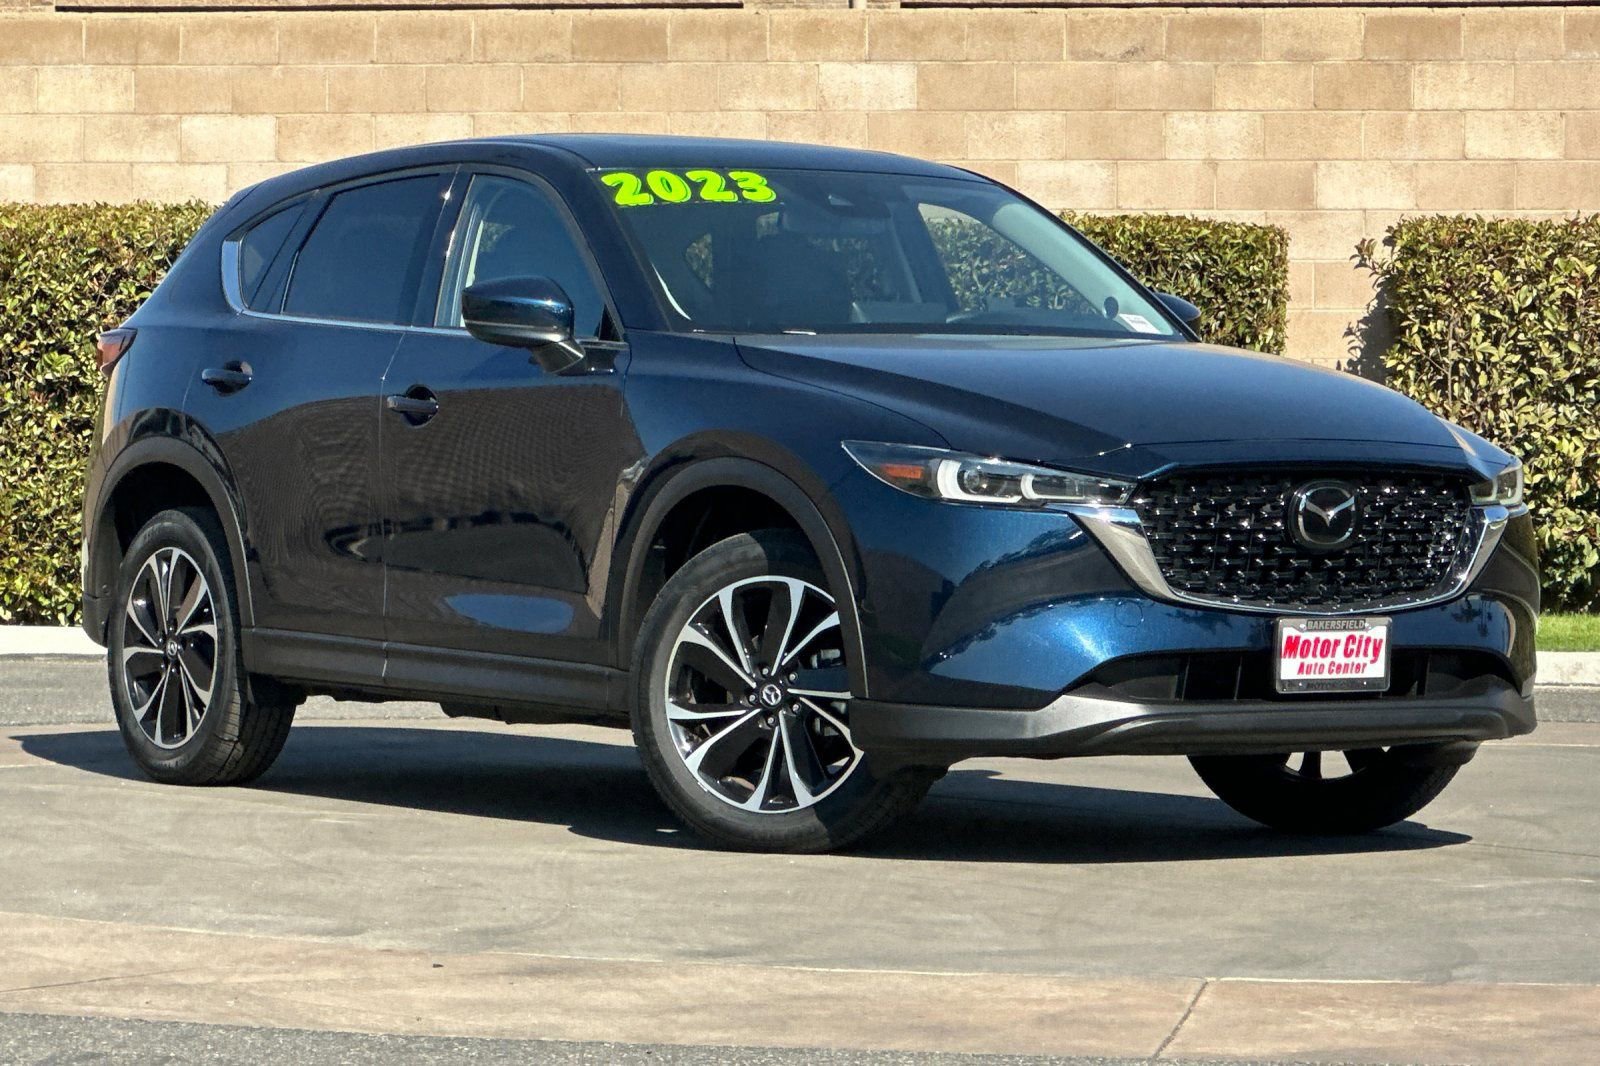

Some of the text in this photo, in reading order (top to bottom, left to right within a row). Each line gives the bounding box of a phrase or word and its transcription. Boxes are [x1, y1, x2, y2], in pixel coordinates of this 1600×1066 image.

[600, 170, 777, 207] 2023
[1307, 620, 1365, 630] BAKERSFIELD
[1281, 634, 1384, 664] Motor City
[1297, 661, 1367, 675] Auto Center
